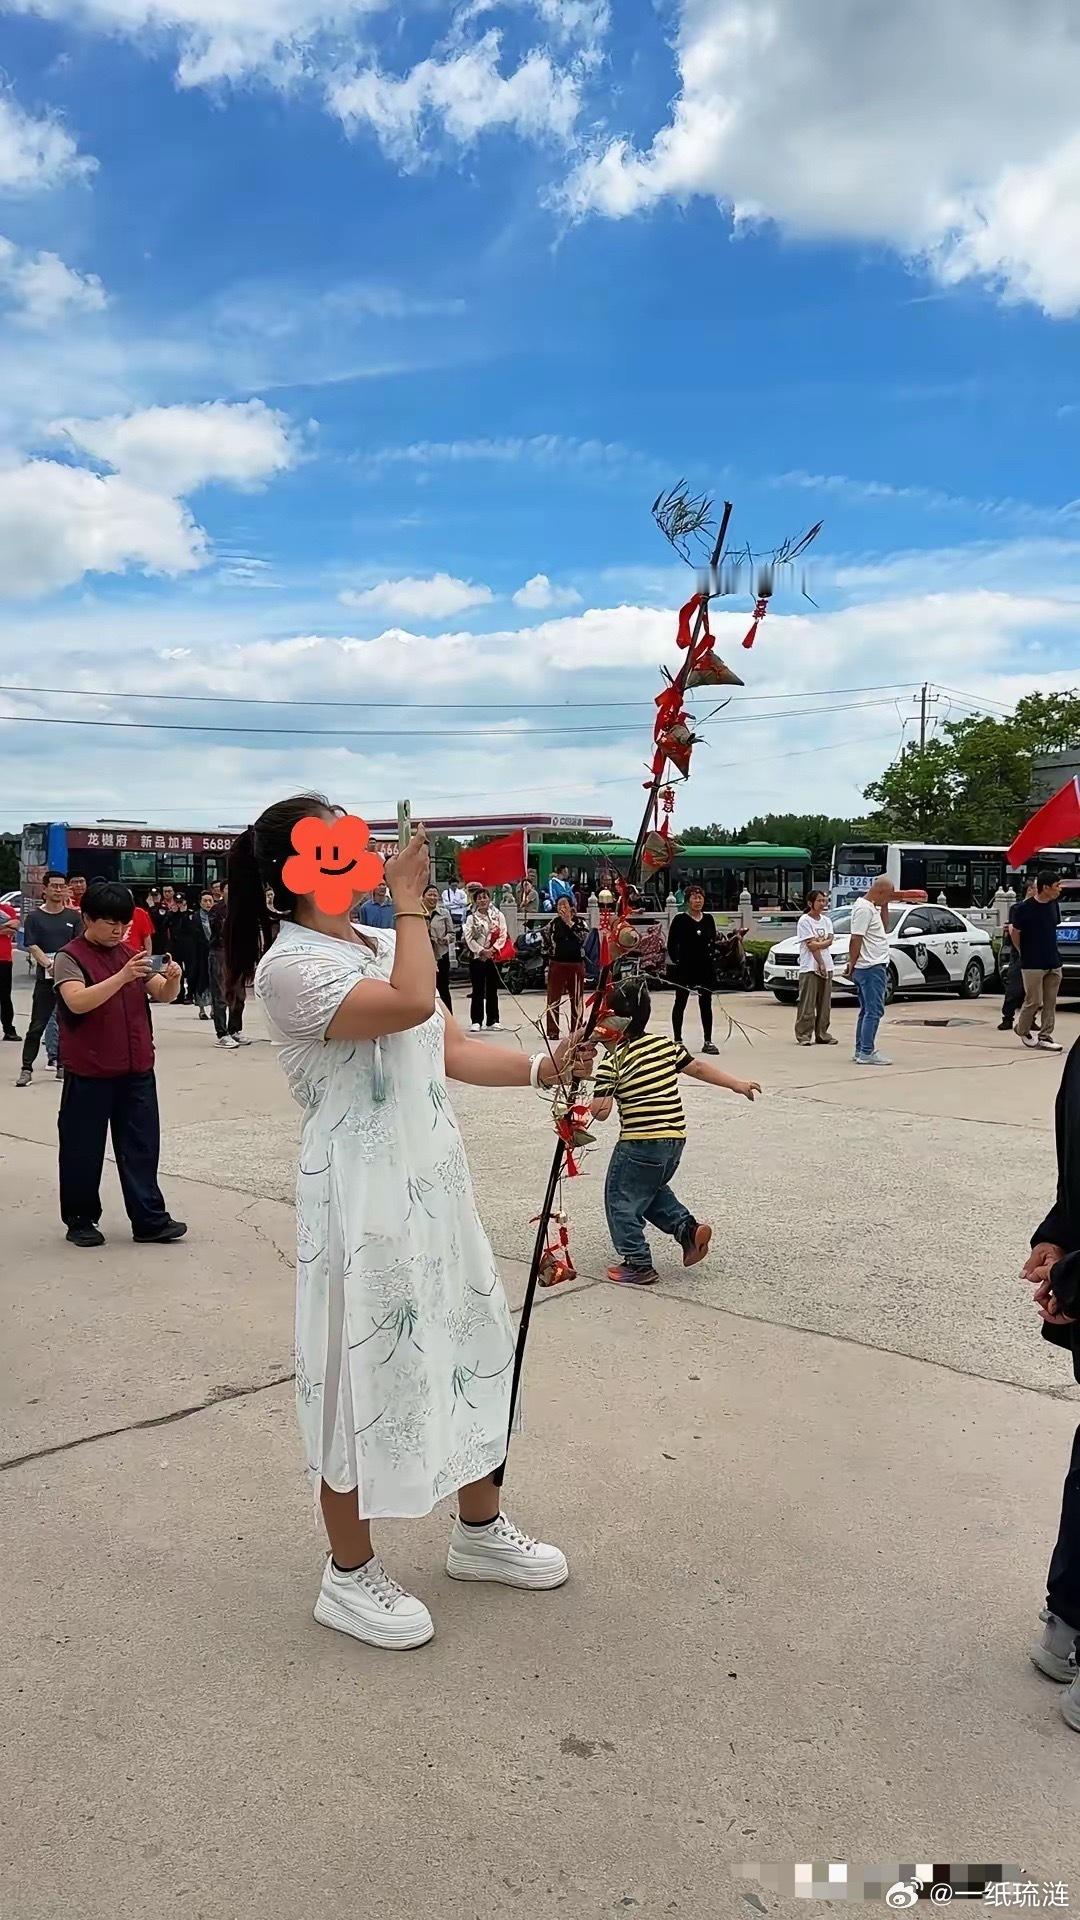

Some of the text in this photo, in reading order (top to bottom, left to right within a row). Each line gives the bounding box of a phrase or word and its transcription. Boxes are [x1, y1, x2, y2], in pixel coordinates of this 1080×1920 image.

[140, 835, 193, 850] 新品加推
[944, 940, 959, 955] 公安
